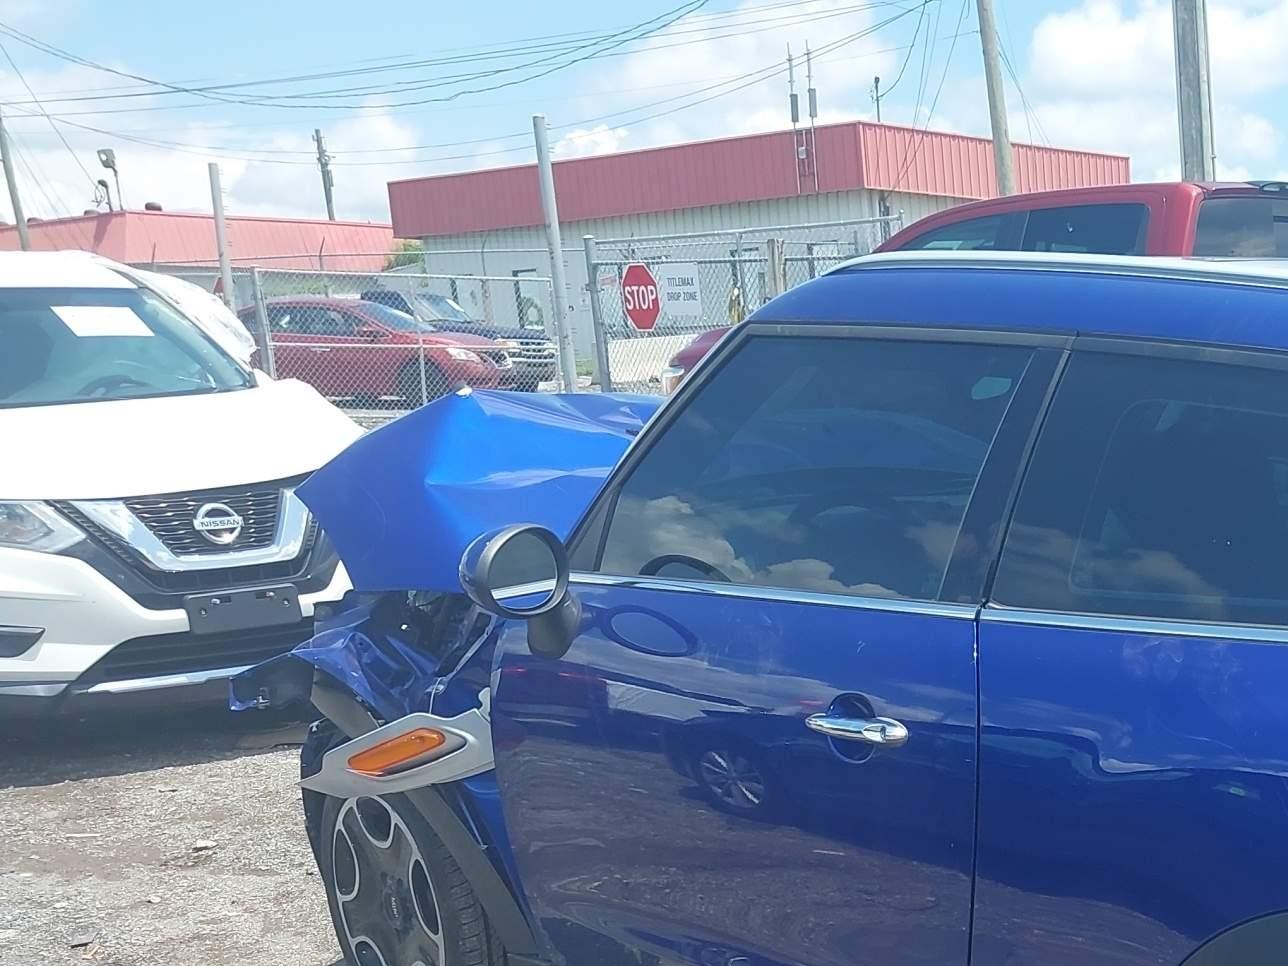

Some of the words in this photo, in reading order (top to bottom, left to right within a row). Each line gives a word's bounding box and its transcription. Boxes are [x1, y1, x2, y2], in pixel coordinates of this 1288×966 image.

[666, 276, 695, 287] TITLEMAX
[624, 285, 656, 310] STOP
[667, 290, 681, 302] DROP
[683, 290, 698, 302] ZONE
[200, 518, 240, 528] NISSAN
